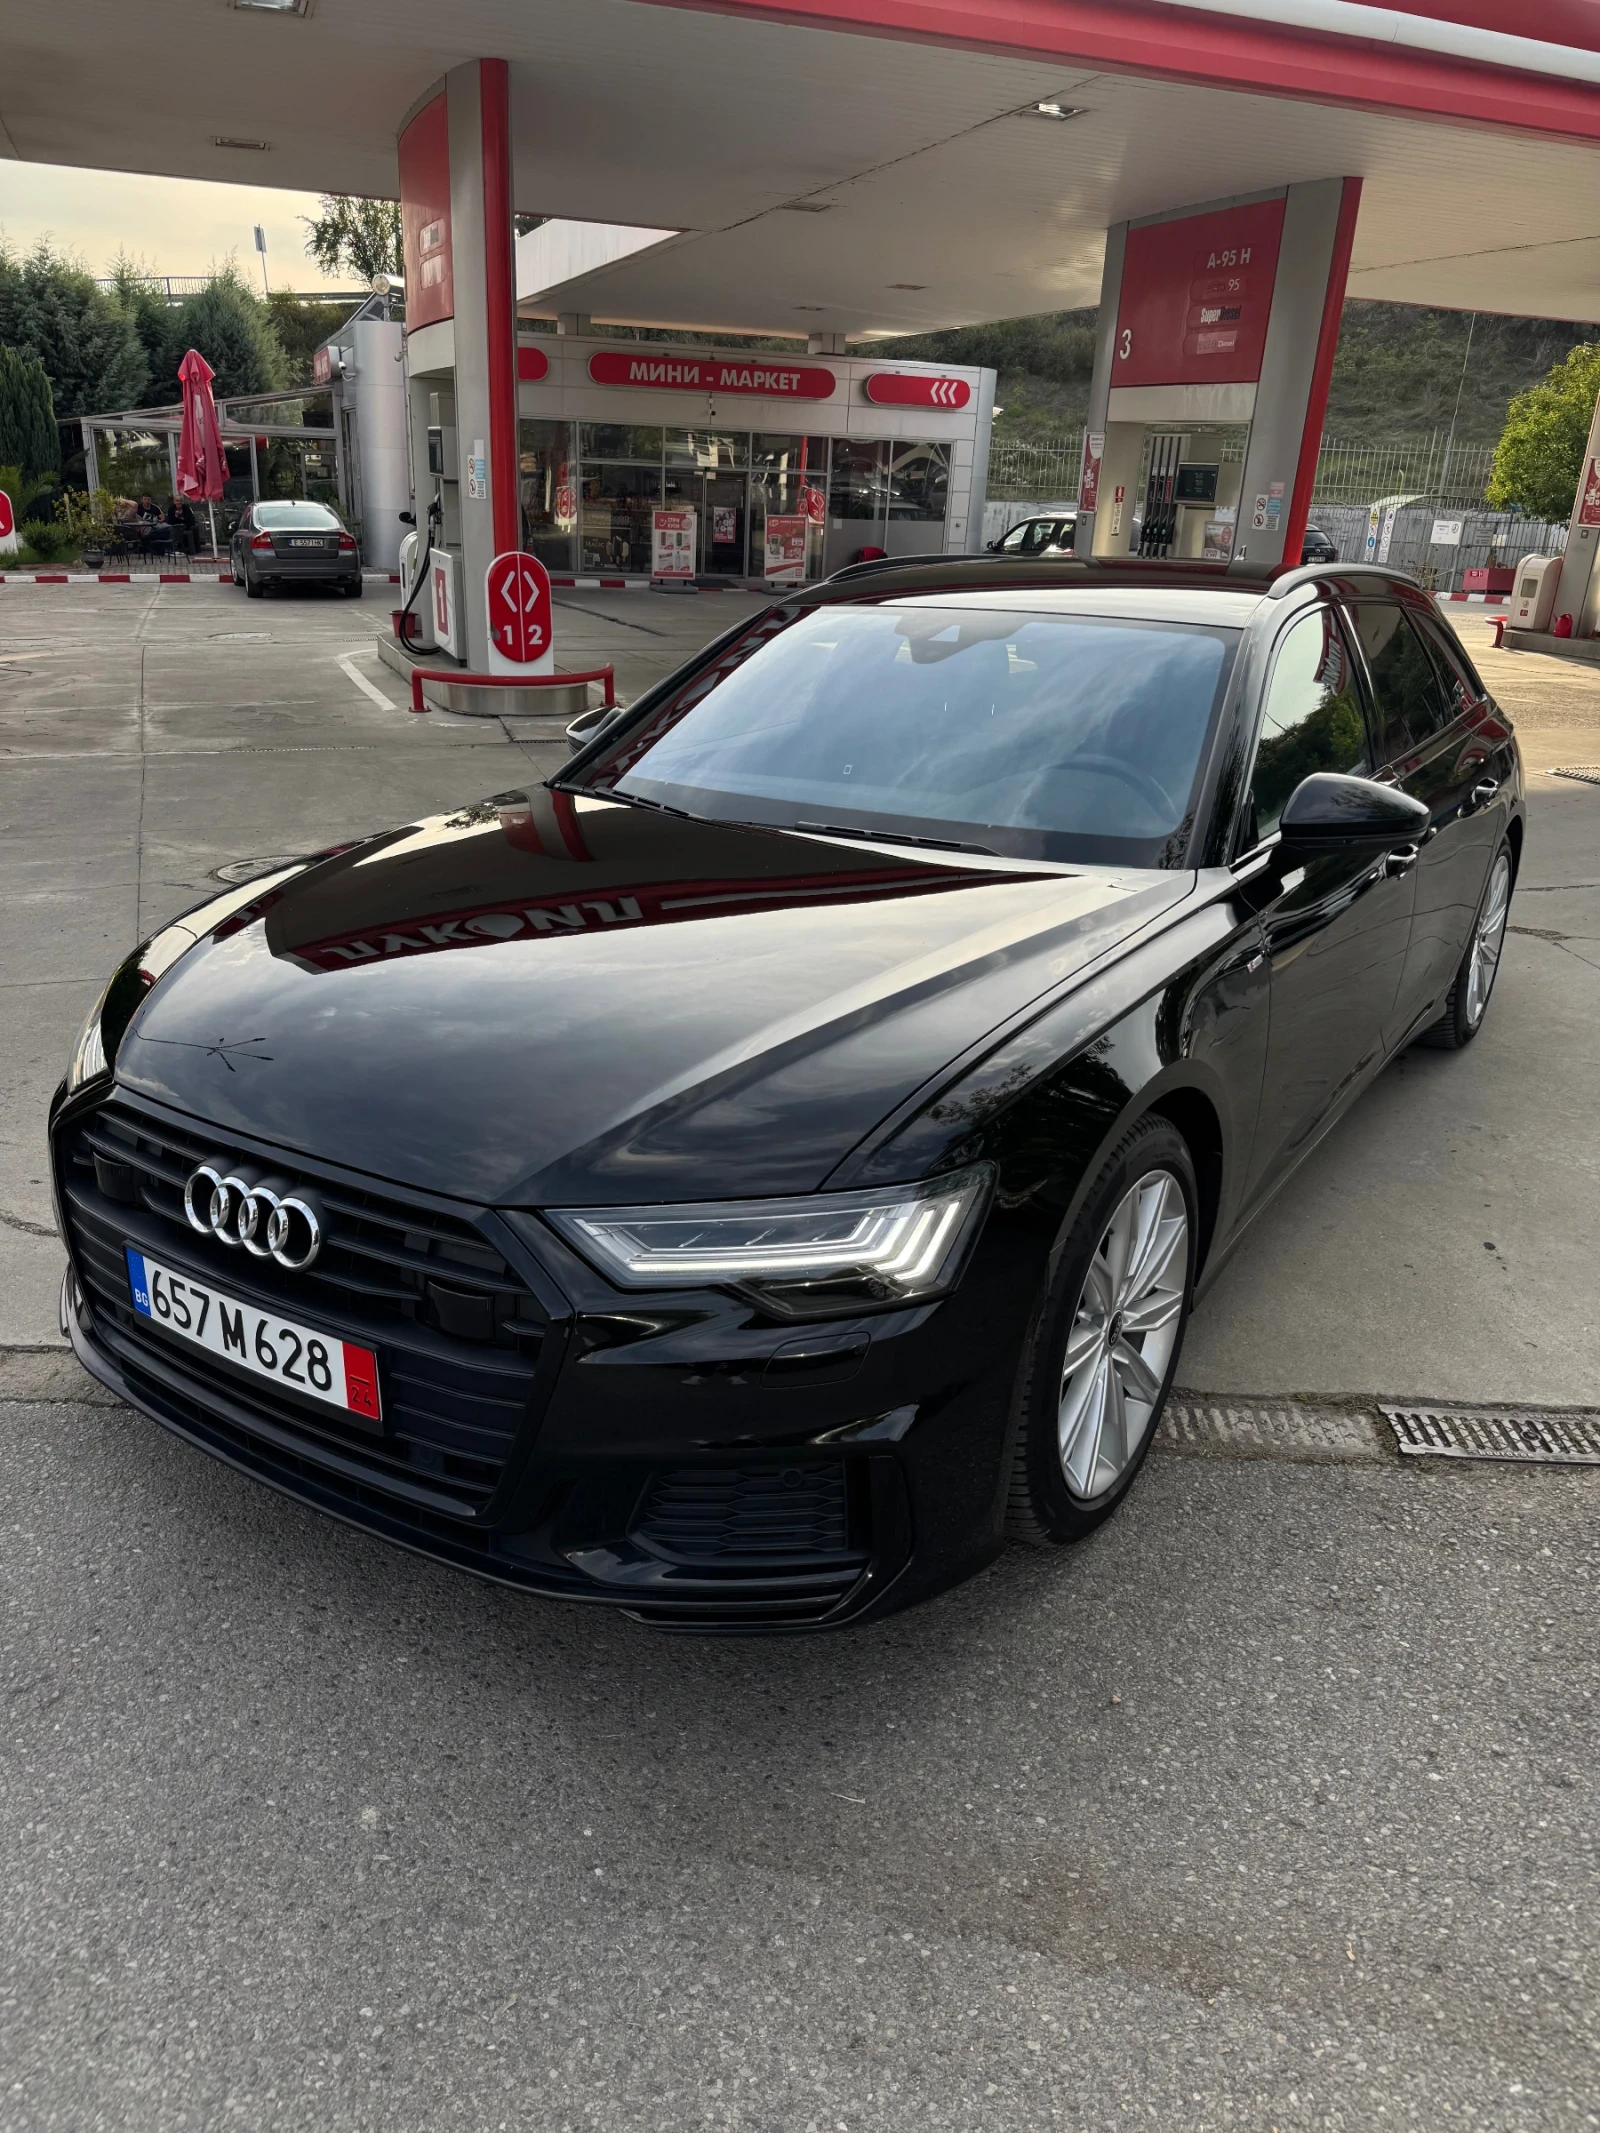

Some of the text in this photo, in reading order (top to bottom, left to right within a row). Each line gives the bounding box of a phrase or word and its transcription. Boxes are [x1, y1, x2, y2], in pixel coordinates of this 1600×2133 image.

[1228, 278, 1240, 291] 95
[1119, 329, 1132, 360] 3
[629, 361, 699, 384] МИНИ
[719, 369, 801, 391] МАРКЕТ
[503, 625, 543, 645] 1 2
[134, 1287, 149, 1308] BG
[152, 1269, 333, 1392] 657 M 628
[351, 1386, 373, 1407] 24
